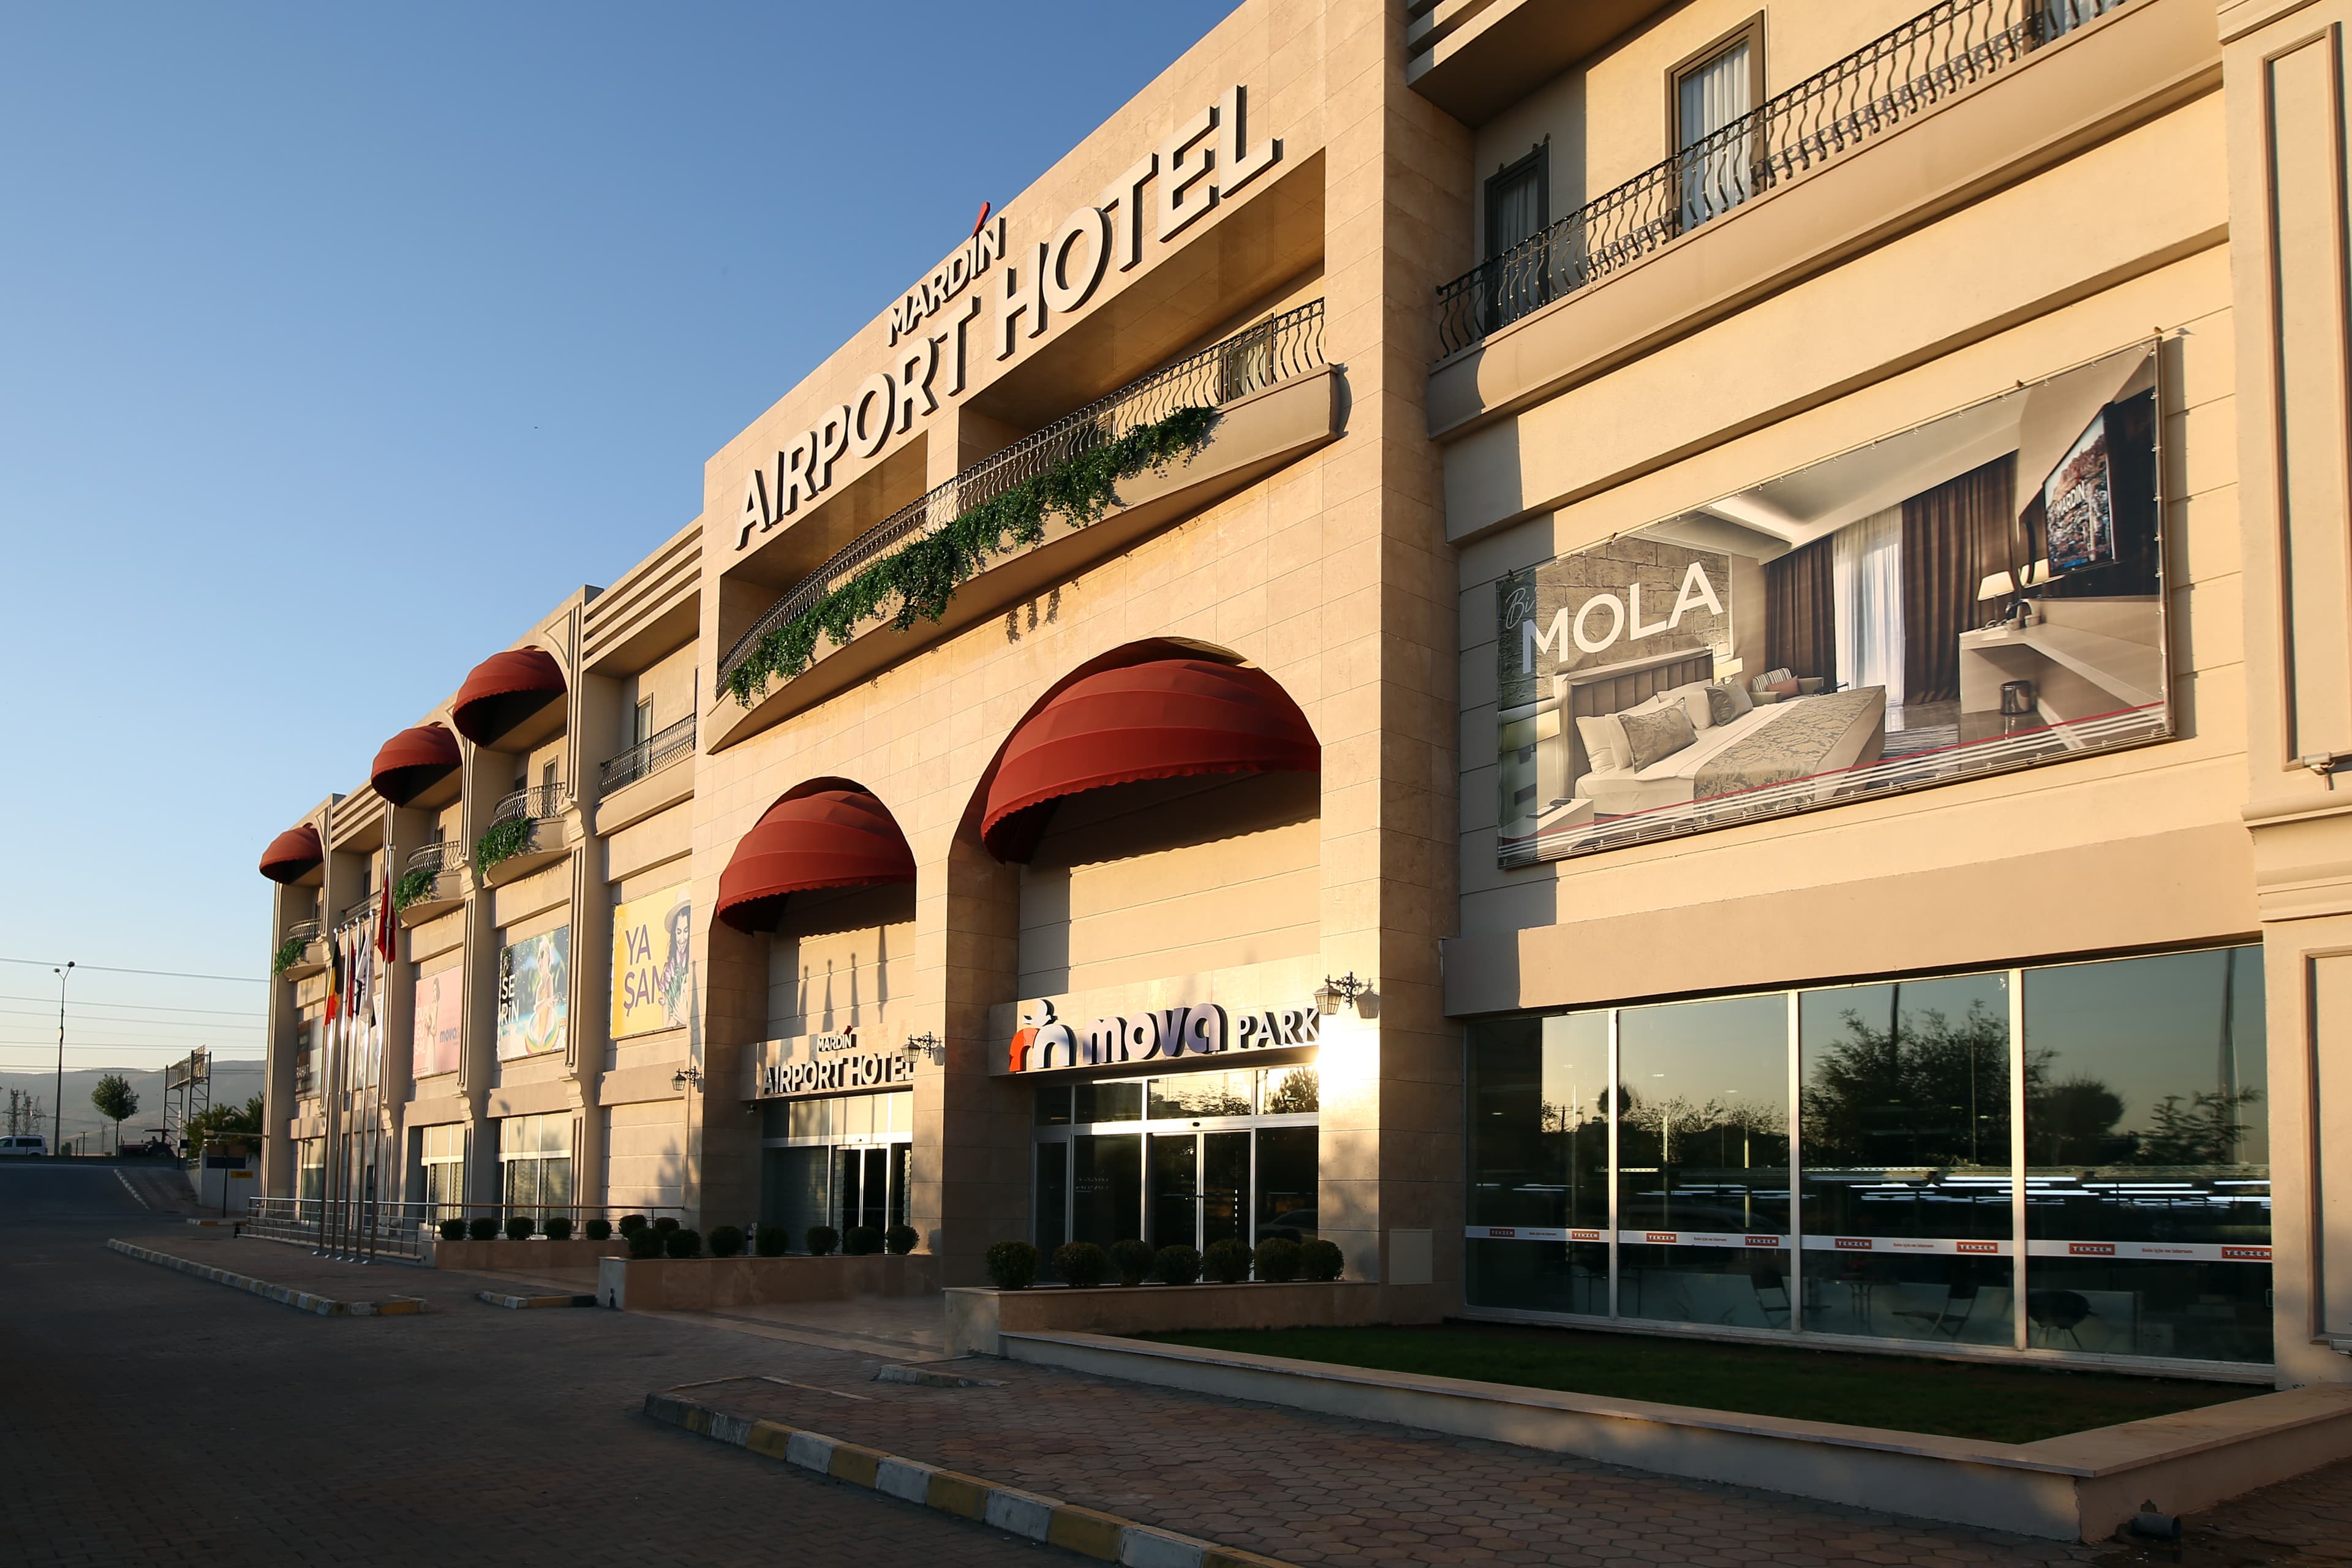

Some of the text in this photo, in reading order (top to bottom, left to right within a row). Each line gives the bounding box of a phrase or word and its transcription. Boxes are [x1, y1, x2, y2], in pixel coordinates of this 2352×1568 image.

[736, 84, 1283, 550] AIRPORT HOTEL
[1523, 562, 1724, 674] MOLA
[625, 924, 651, 965] YA
[502, 974, 515, 1000] SE
[1083, 1003, 1228, 1065] mova
[1237, 1008, 1319, 1048] PARK
[763, 1057, 848, 1095] AIRPORT
